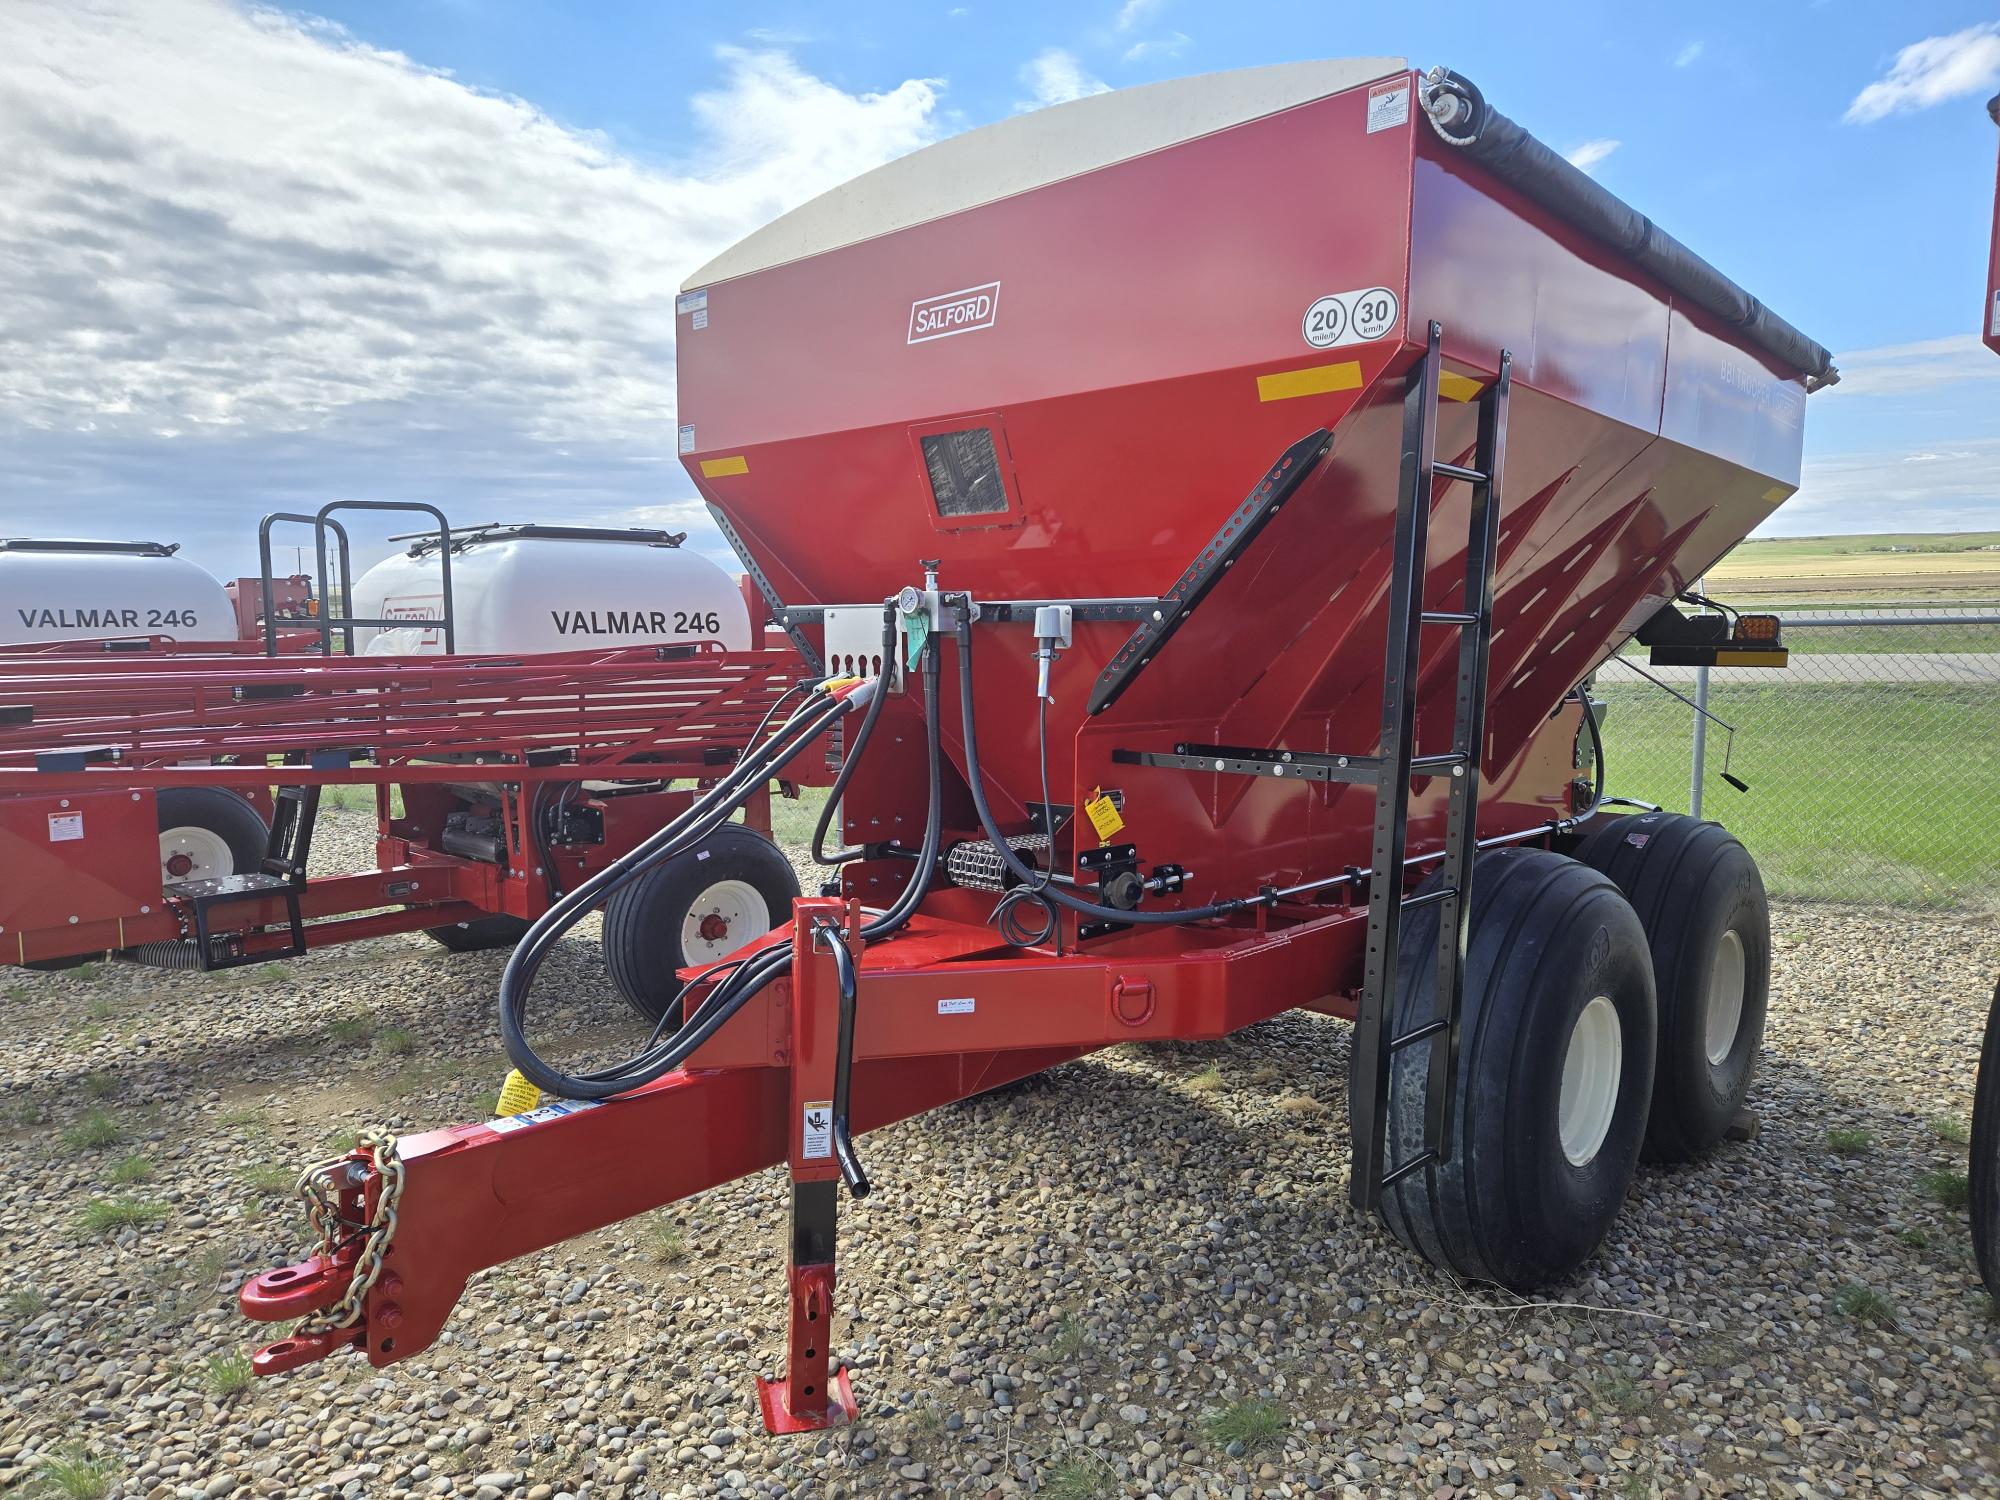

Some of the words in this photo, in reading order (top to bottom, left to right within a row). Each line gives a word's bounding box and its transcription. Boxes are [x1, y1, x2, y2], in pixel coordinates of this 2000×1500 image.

[916, 295, 990, 332] SALFORD
[1312, 309, 1338, 332] 20
[1361, 300, 1388, 323] 30
[1312, 332, 1336, 342] mile/h
[1363, 324, 1384, 334] km/h
[18, 609, 139, 628] VALMAR
[147, 609, 197, 628] 246
[551, 611, 667, 634] VALMAR
[673, 611, 720, 634] 246
